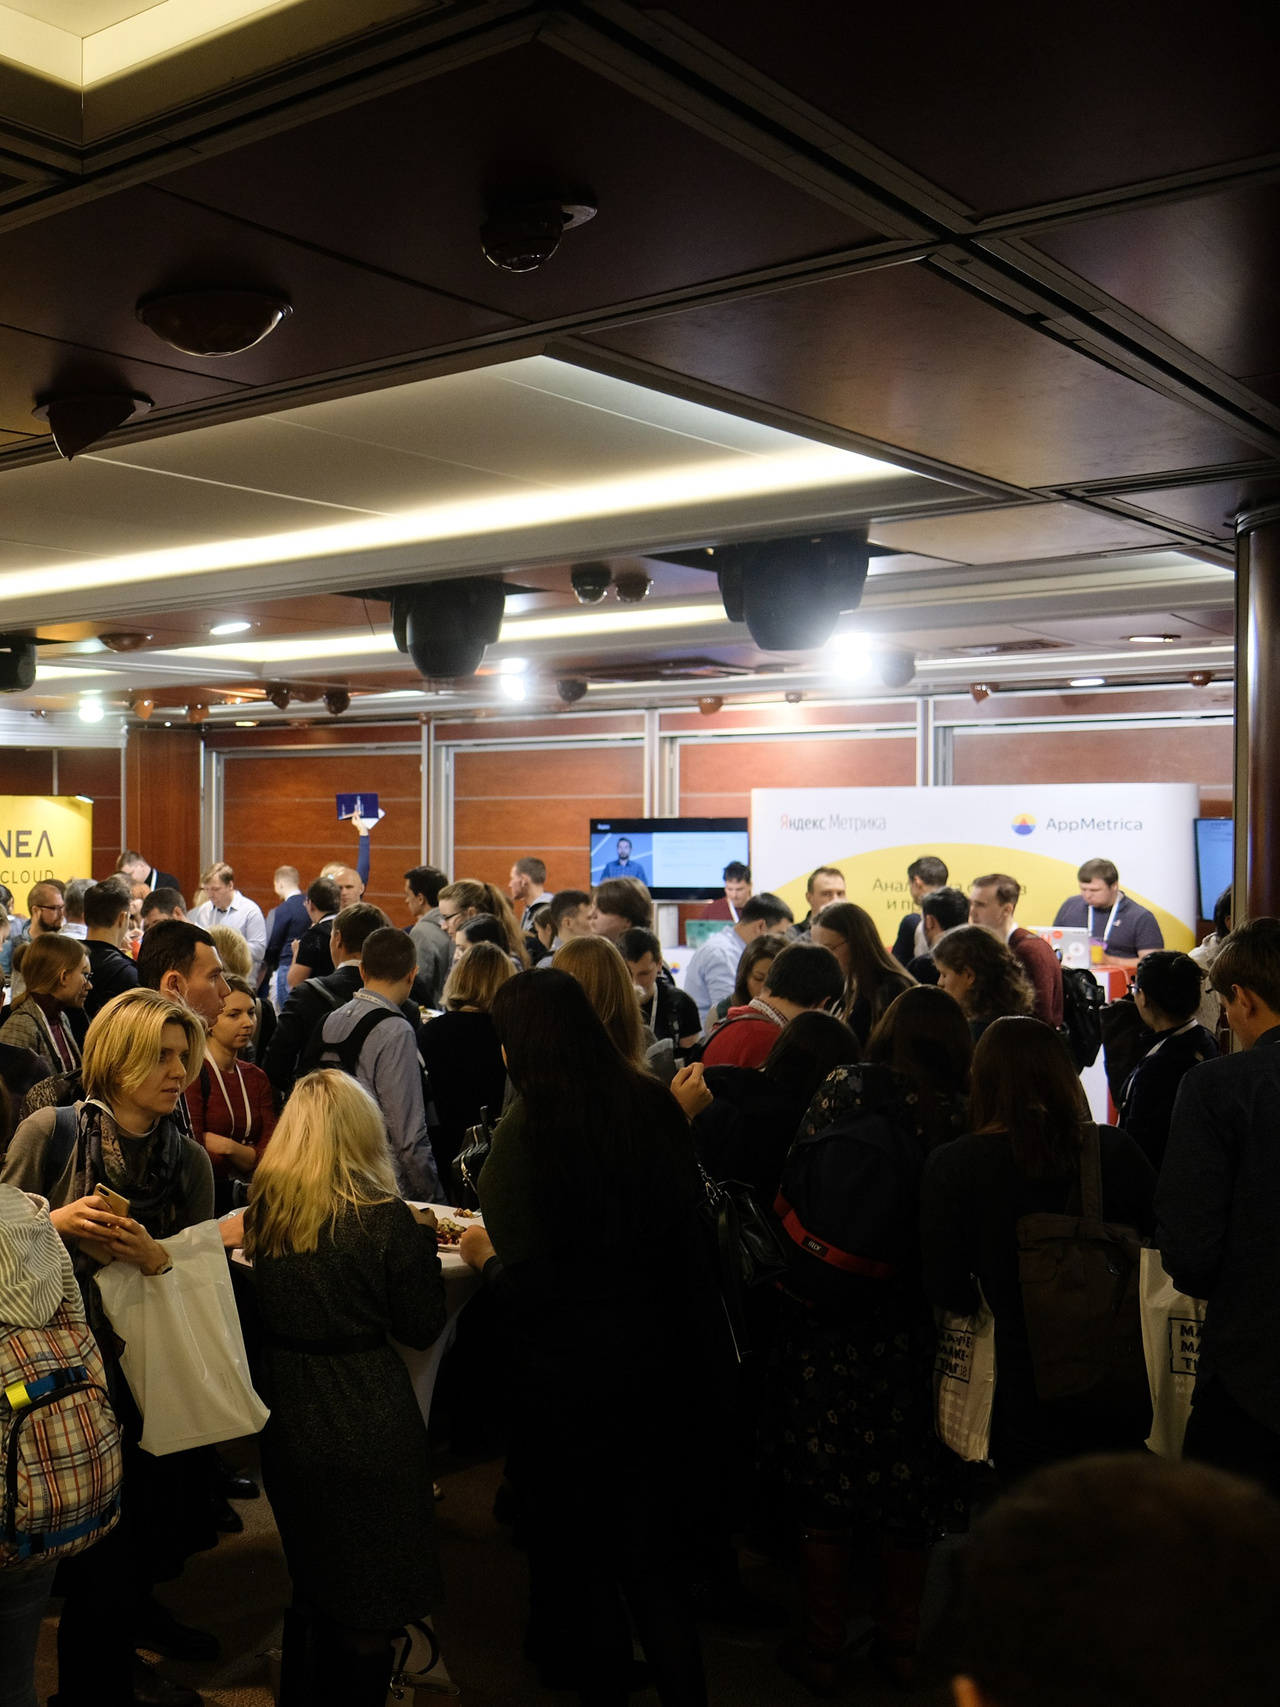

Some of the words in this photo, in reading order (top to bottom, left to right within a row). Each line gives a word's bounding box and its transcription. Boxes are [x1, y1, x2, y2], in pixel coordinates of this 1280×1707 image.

[780, 813, 826, 832] Яндекс
[829, 813, 887, 833] Метрика
[1045, 817, 1143, 834] AppMetrica
[0, 869, 55, 884] CLOUD
